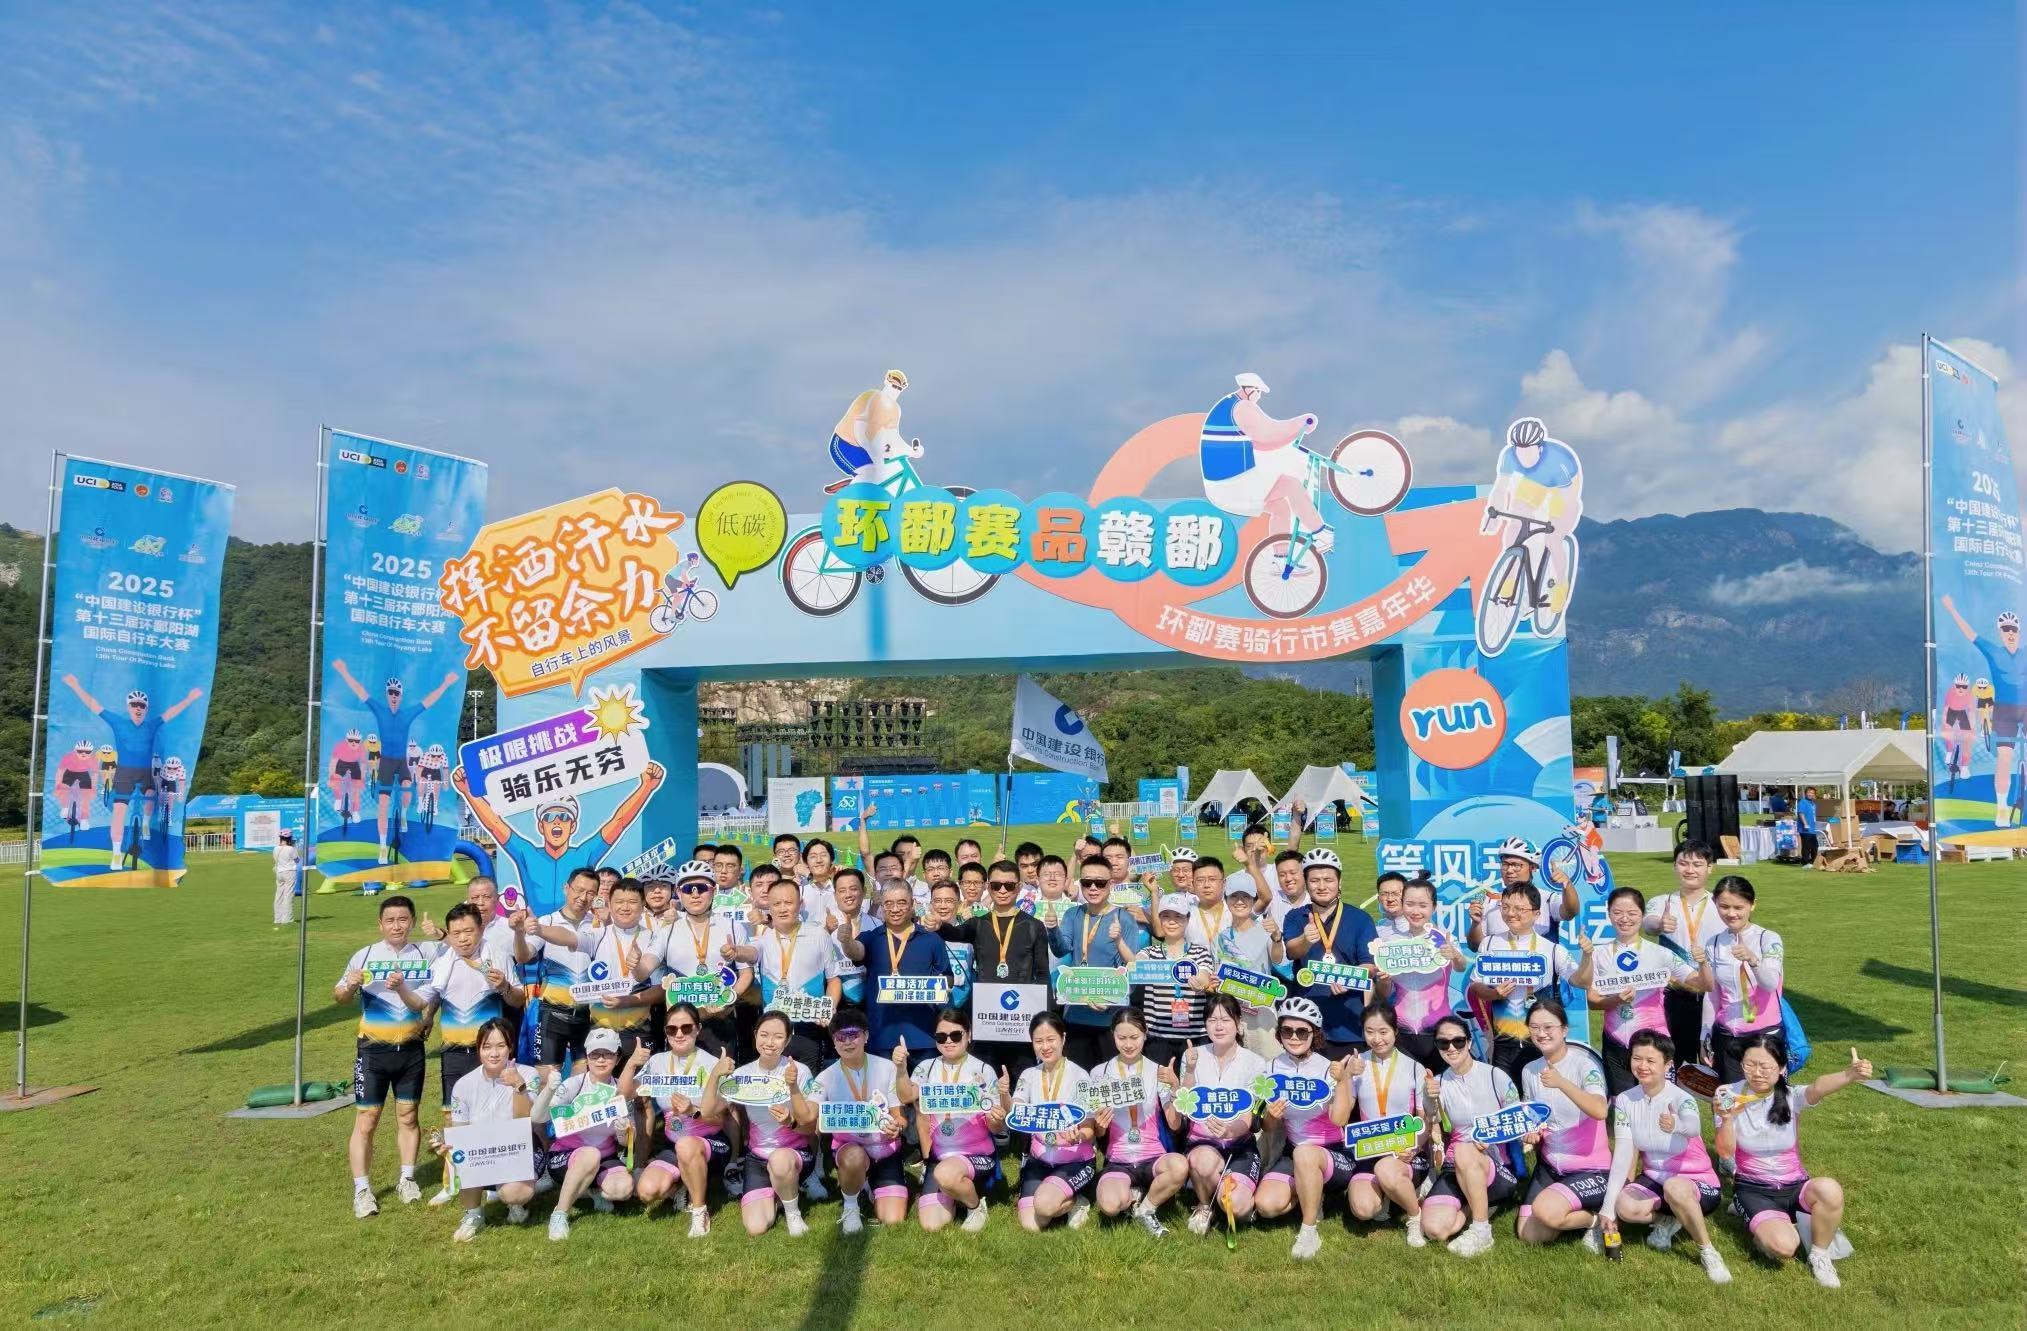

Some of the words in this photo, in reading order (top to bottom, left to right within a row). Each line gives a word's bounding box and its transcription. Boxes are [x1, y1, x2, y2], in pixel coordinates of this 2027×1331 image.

[342, 452, 361, 462] UCI
[77, 476, 97, 487] UCI
[715, 511, 767, 538] 低碳
[834, 498, 1223, 571] 环鄱赛品赣鄱
[372, 552, 432, 580] 2025
[442, 498, 681, 612] 挥洒汗水
[107, 571, 175, 598] 2025
[343, 574, 444, 603] “中国建设银行
[75, 593, 202, 620] “中国建设银行杯”
[465, 561, 655, 666] 不留余力
[1156, 576, 1437, 655] 环鄱赛骑行市集嘉年华
[74, 609, 199, 638] 第十三届环鄱阳湖
[351, 608, 447, 634] 国际自行车大赛
[83, 626, 191, 652] 国际自行车大赛
[415, 637, 432, 646] Bank
[417, 645, 433, 653] Lake
[111, 654, 128, 662] Tour
[157, 653, 176, 662] Bank
[531, 629, 634, 679] 自行车上的风景
[1412, 700, 1492, 737] run
[478, 723, 579, 770] 极限挑战
[1021, 727, 1105, 767] 中国建设银行
[1023, 742, 1042, 754] China
[1044, 748, 1088, 768] Construction
[501, 745, 626, 804] 骑乐无穷
[572, 981, 630, 994] 中国建设银行
[671, 982, 714, 992] 脚下有轮
[1595, 971, 1667, 986] 中国建设银行
[774, 990, 832, 1009] 您的普惠金融
[977, 1012, 1032, 1021] 中国建设银
[735, 1076, 770, 1085] 团队一心
[921, 1085, 966, 1096] 建行陪伴
[1078, 1077, 1142, 1097] 您的普惠金融
[822, 1104, 866, 1115] 建行陪伴
[468, 1143, 527, 1157] 中国建设银行
[1067, 1169, 1087, 1187] TOUR
[1570, 1177, 1597, 1192] TOUR
